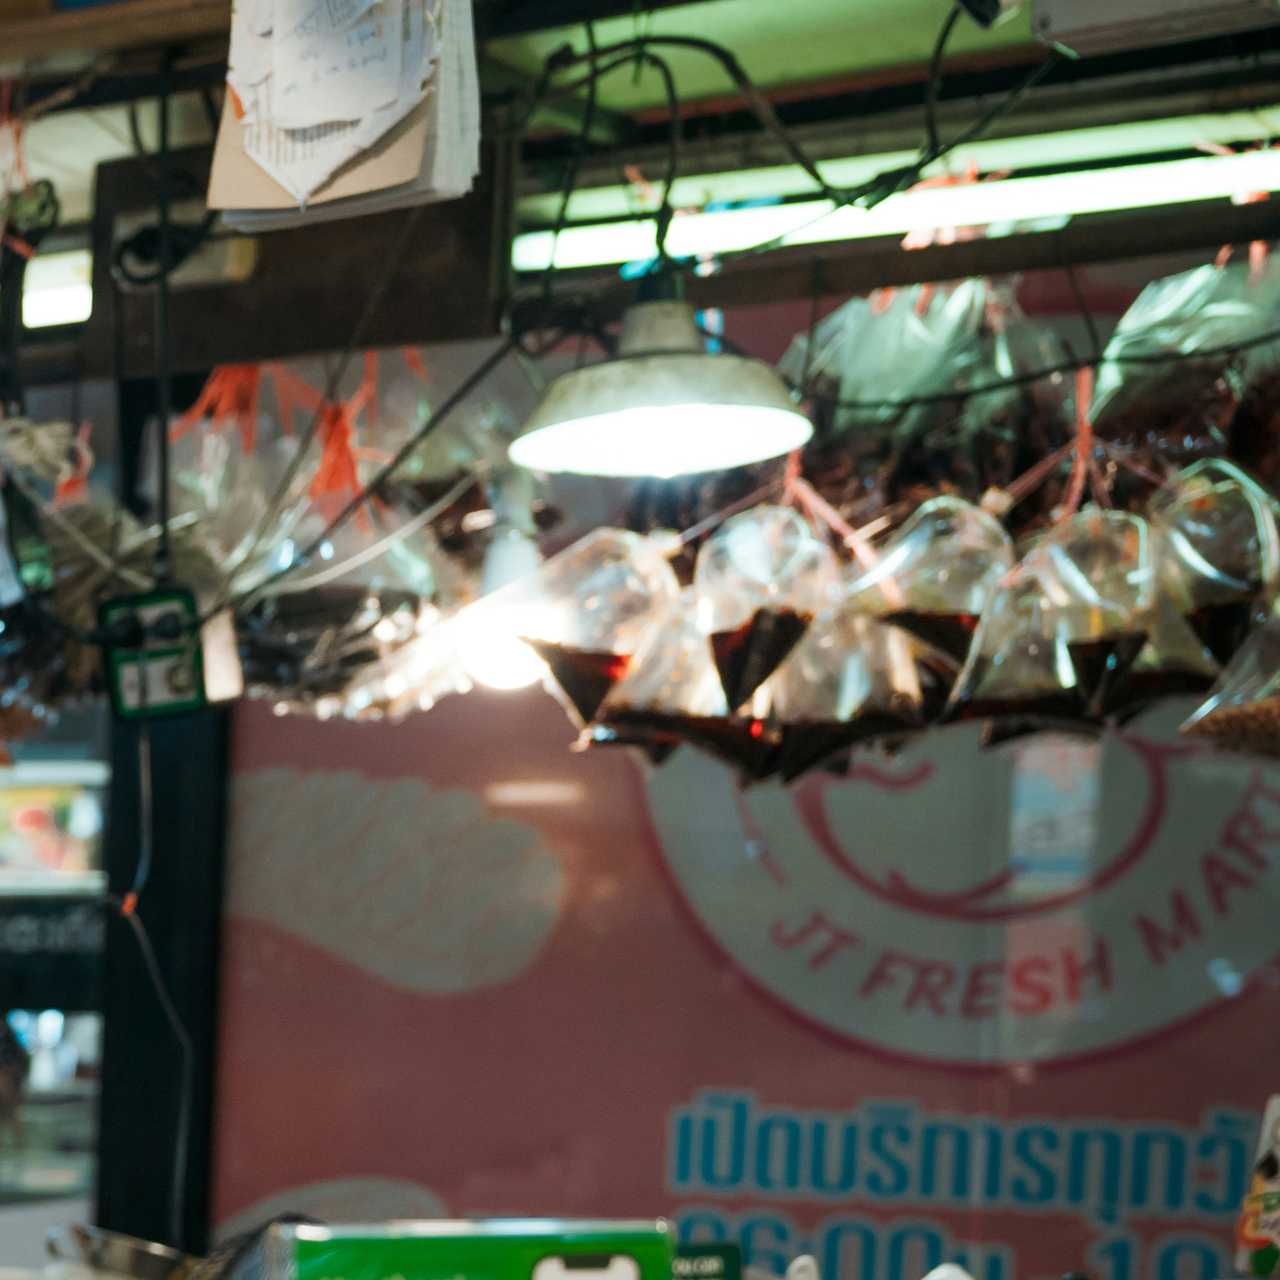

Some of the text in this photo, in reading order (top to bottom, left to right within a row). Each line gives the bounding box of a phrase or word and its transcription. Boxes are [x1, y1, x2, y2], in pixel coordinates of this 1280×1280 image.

[857, 938, 1114, 1018] FRESH
[674, 1096, 1248, 1223] เปิดบริการทุกวั
